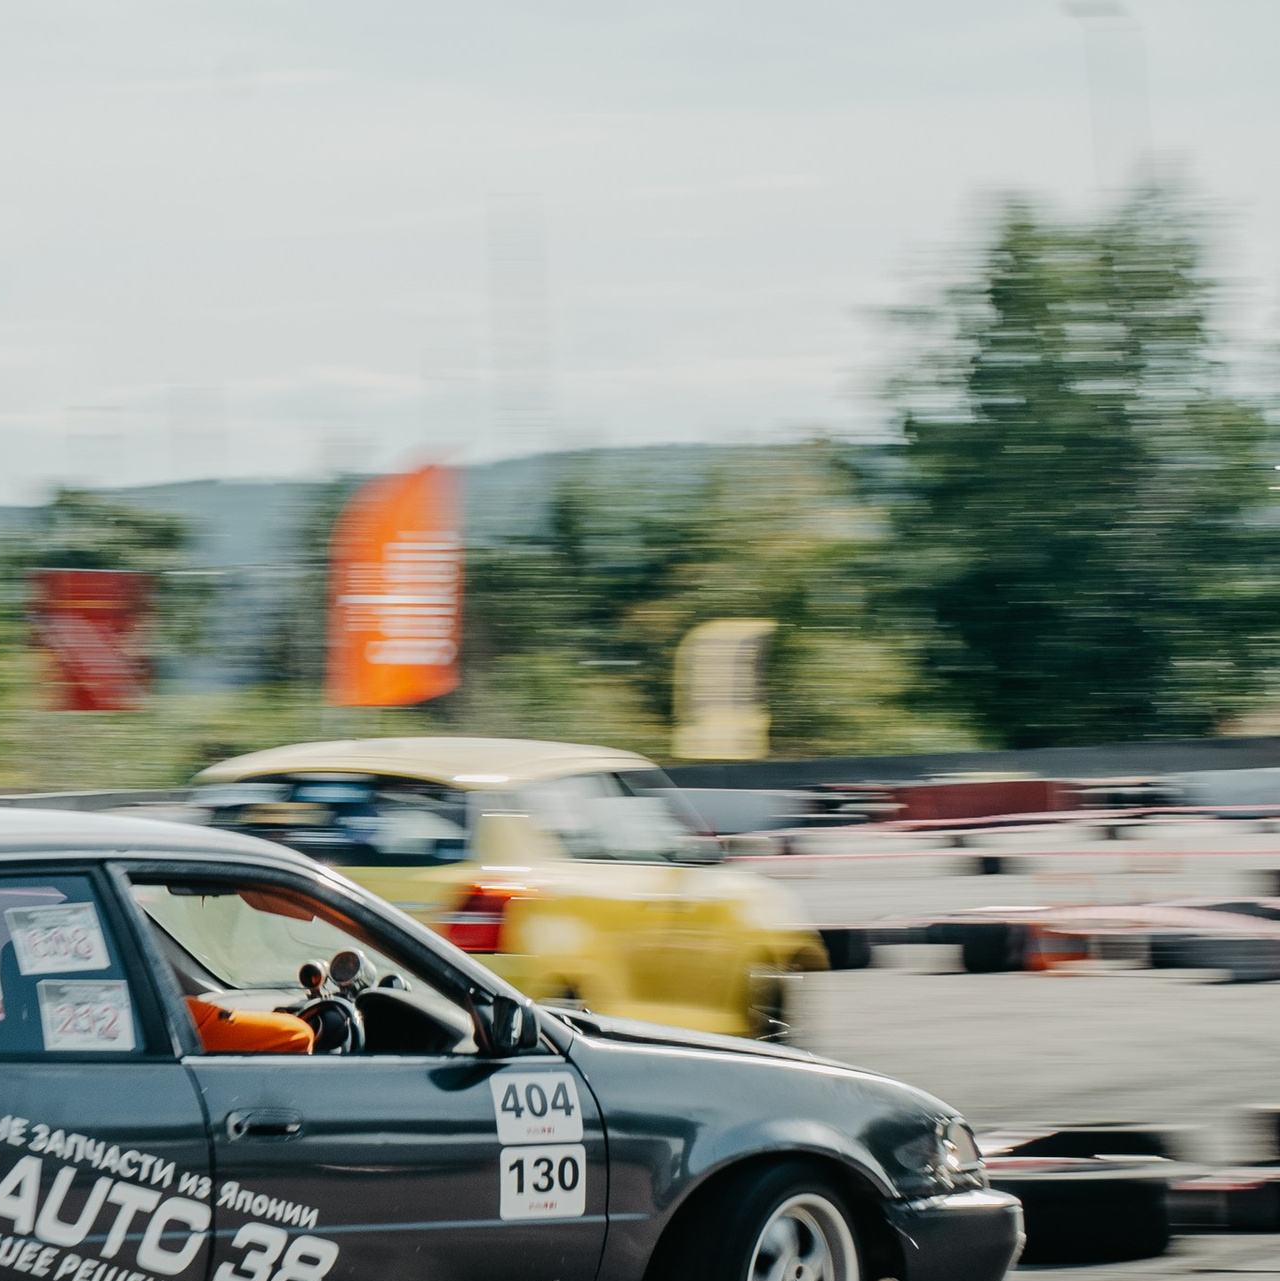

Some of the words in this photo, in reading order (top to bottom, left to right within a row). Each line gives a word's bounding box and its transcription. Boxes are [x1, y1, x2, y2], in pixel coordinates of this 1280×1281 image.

[501, 1082, 575, 1118] 404
[28, 1123, 176, 1188] ЗАПЧАСТИ
[216, 1181, 319, 1230] Японии
[509, 1156, 580, 1194] 130
